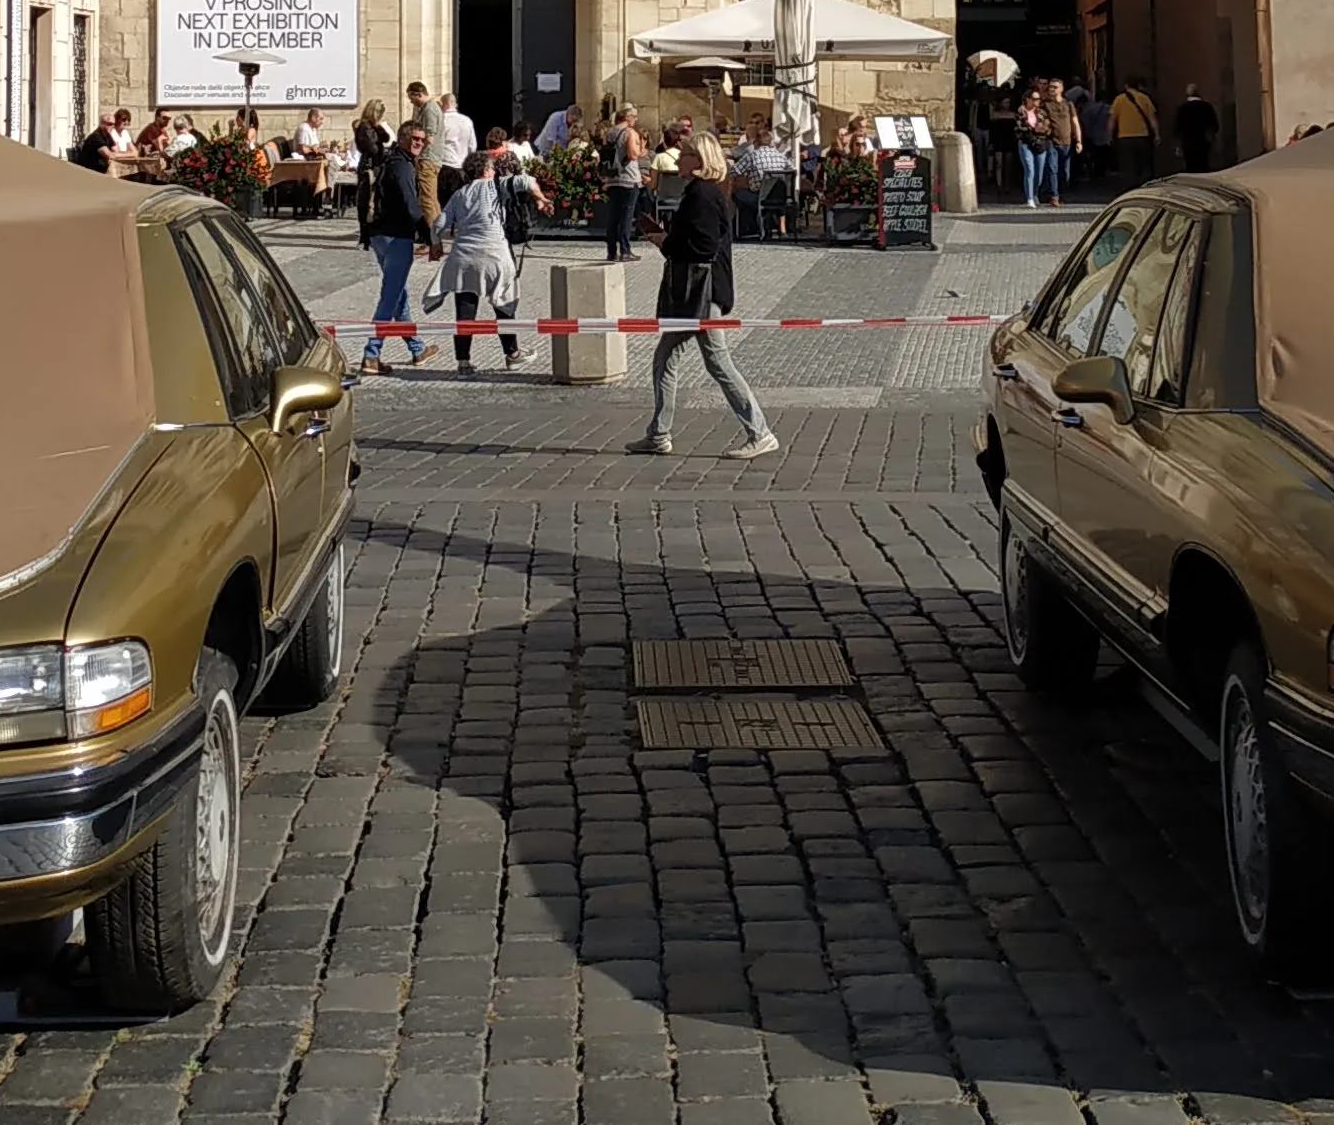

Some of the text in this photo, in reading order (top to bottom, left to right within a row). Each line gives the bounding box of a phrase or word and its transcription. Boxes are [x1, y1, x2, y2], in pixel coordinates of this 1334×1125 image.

[178, 13, 338, 29] NEXT EXHIBITION
[193, 32, 323, 48] IN DECEMBER
[286, 85, 346, 100] ghmp.cz
